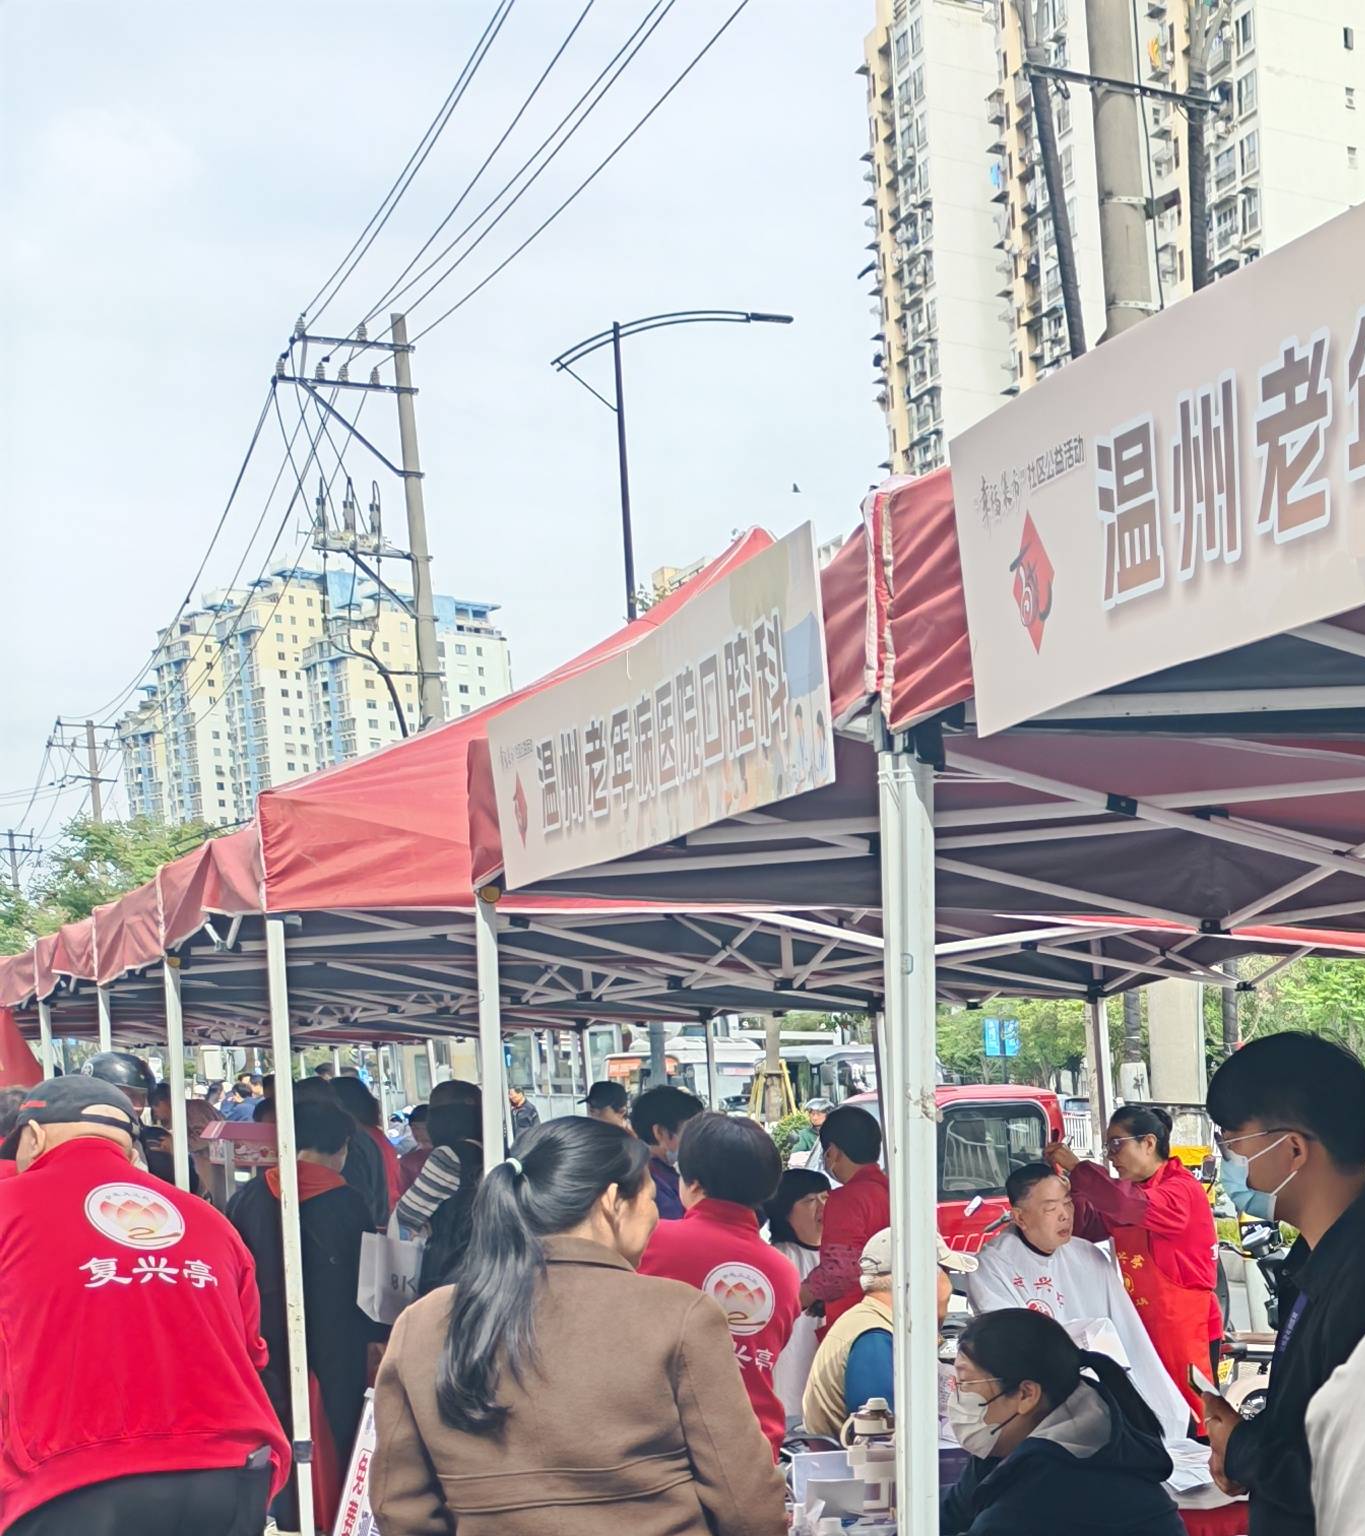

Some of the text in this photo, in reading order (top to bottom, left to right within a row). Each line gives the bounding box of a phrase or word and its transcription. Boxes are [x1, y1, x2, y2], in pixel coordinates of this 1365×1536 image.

[1027, 434, 1085, 490] 社区公益活动
[537, 607, 790, 834] 温州老年病医院口腔科
[79, 1255, 218, 1289] 复兴亭
